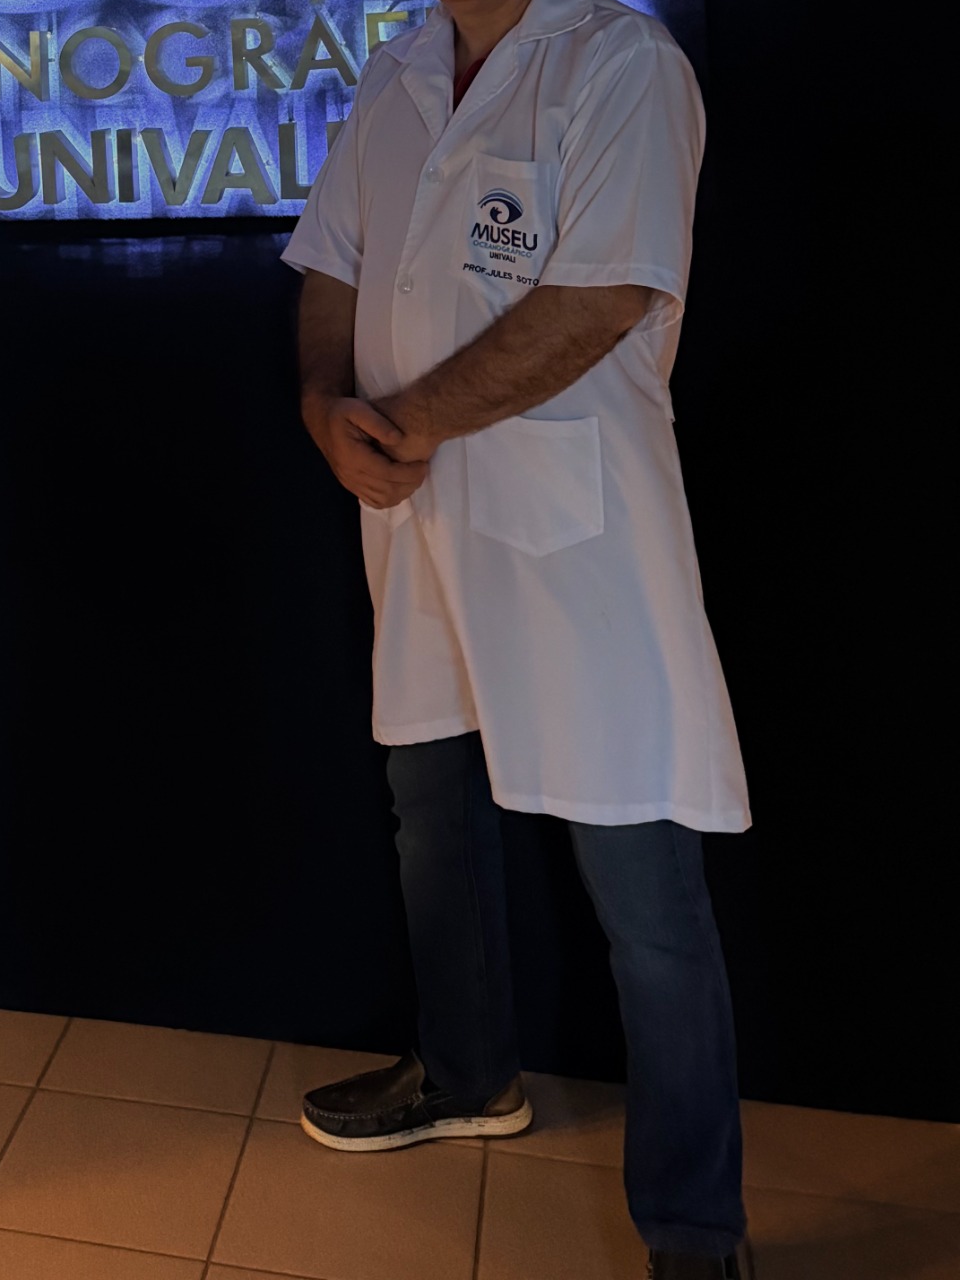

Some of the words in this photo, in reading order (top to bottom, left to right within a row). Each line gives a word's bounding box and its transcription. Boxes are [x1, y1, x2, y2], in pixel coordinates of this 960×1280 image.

[470, 222, 538, 251] MUSEU
[489, 251, 516, 263] UNIVALI
[516, 274, 540, 286] SOTO
